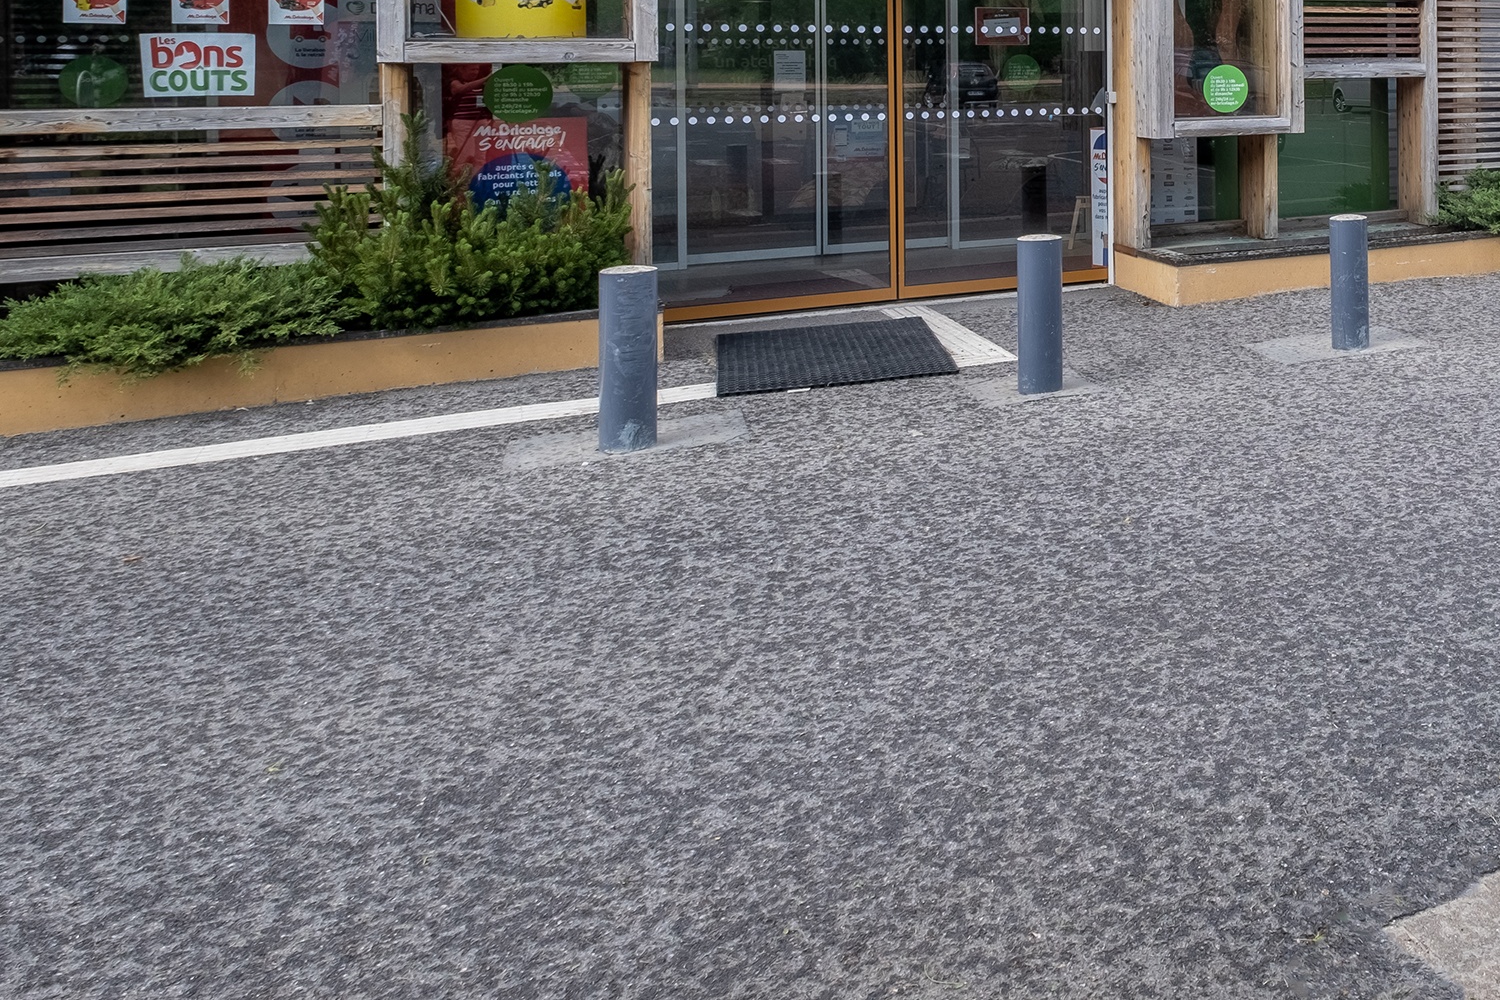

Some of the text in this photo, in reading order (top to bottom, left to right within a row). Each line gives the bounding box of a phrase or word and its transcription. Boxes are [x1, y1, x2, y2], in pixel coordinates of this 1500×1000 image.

[159, 37, 176, 46] Les
[150, 37, 244, 69] bons
[473, 123, 562, 137] Mr.Bricolage
[495, 163, 527, 172] auprès
[477, 170, 562, 181] fabricants fraais
[492, 182, 515, 190] pour
